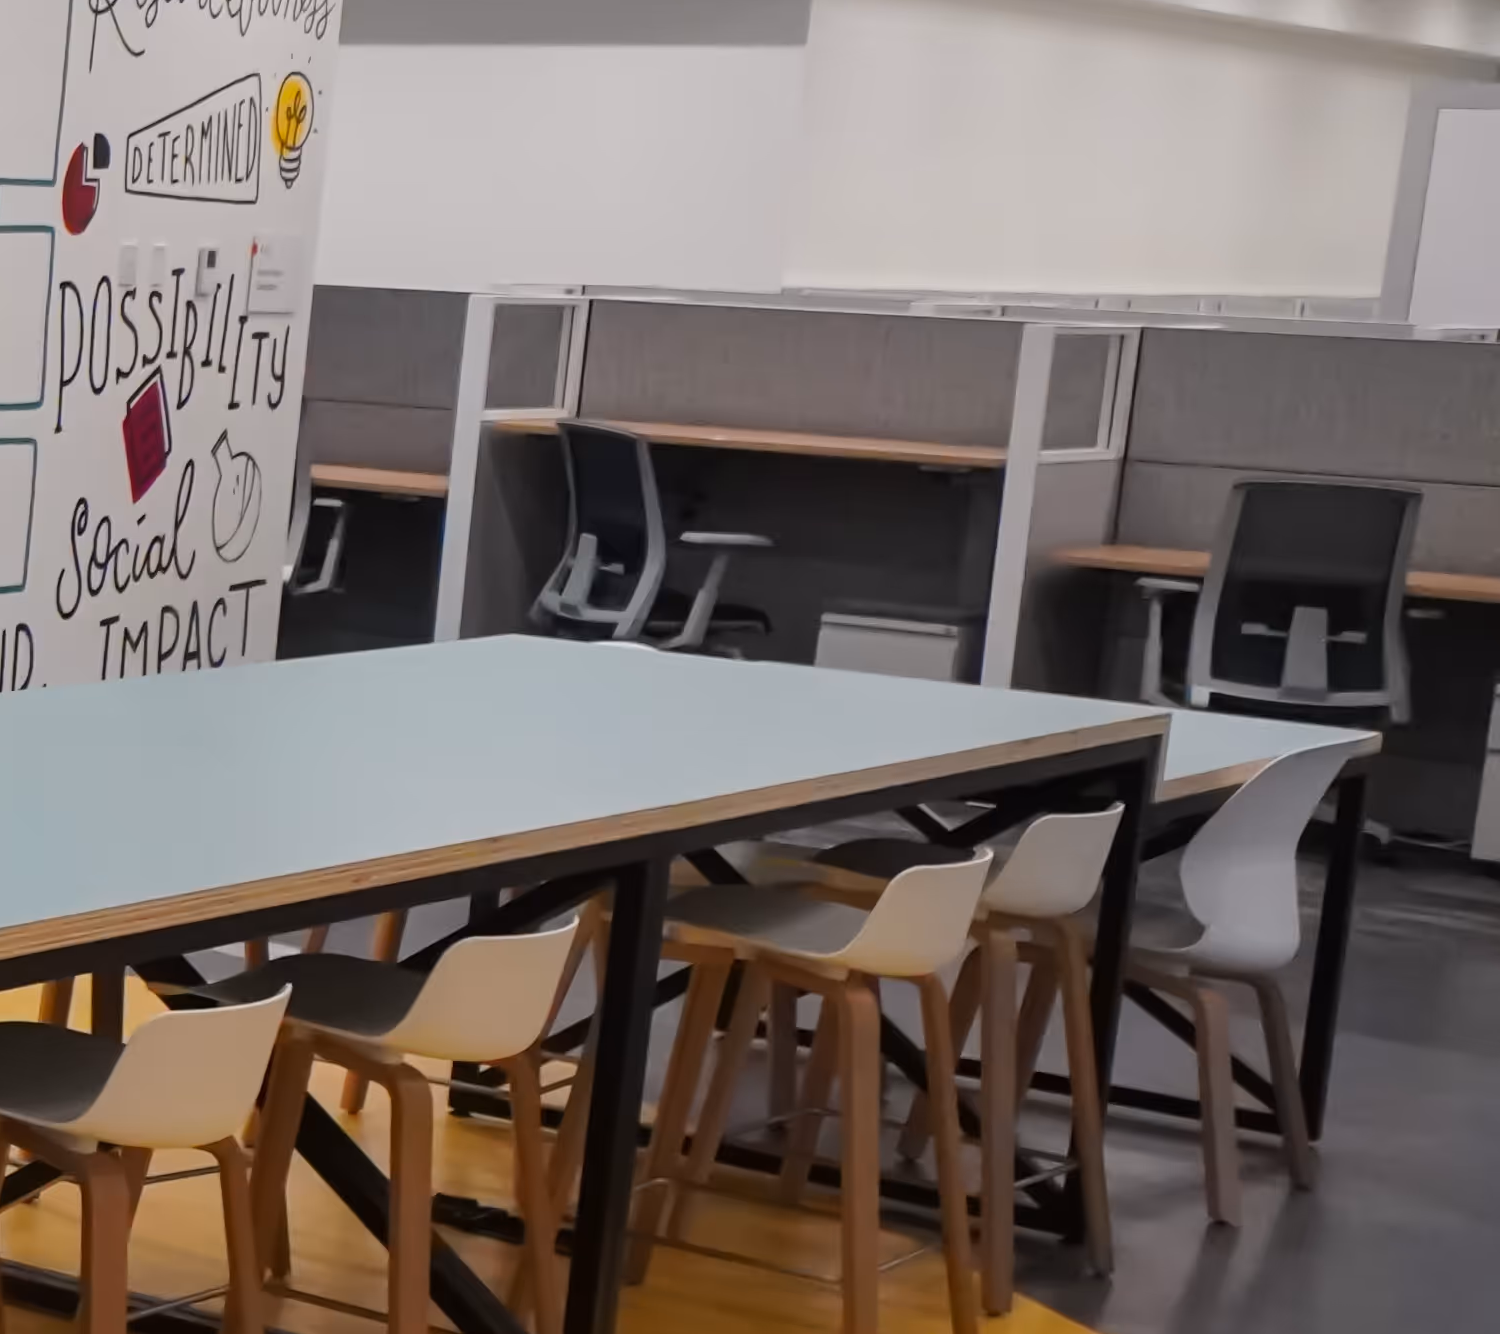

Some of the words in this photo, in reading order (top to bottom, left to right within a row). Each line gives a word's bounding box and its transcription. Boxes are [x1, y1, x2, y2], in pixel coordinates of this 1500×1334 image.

[130, 95, 258, 186] DETERMINED
[55, 458, 196, 620] Social
[99, 578, 268, 682] IMPACT
